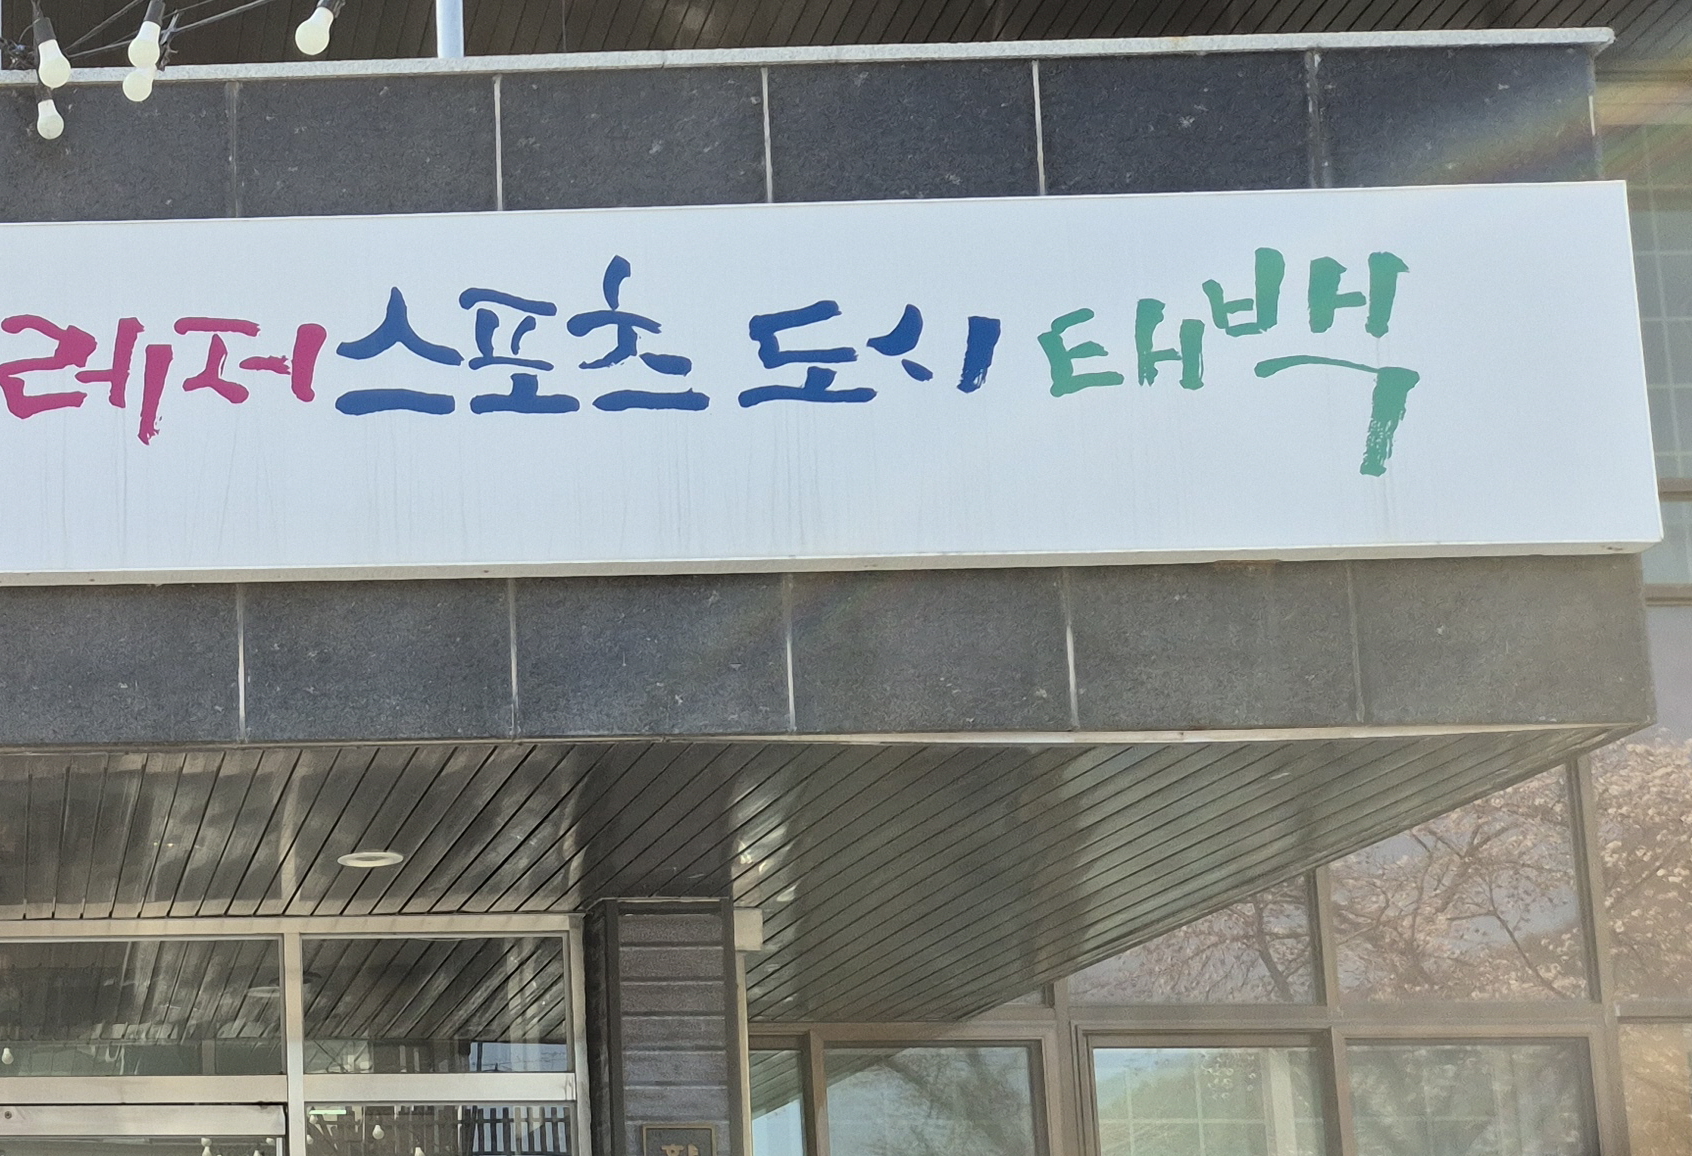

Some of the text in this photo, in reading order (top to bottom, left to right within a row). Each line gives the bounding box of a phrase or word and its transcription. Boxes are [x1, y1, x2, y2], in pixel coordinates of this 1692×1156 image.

[335, 255, 710, 415] 스포츠
[738, 300, 1001, 408] 도시
[1037, 247, 1420, 477] 태백
